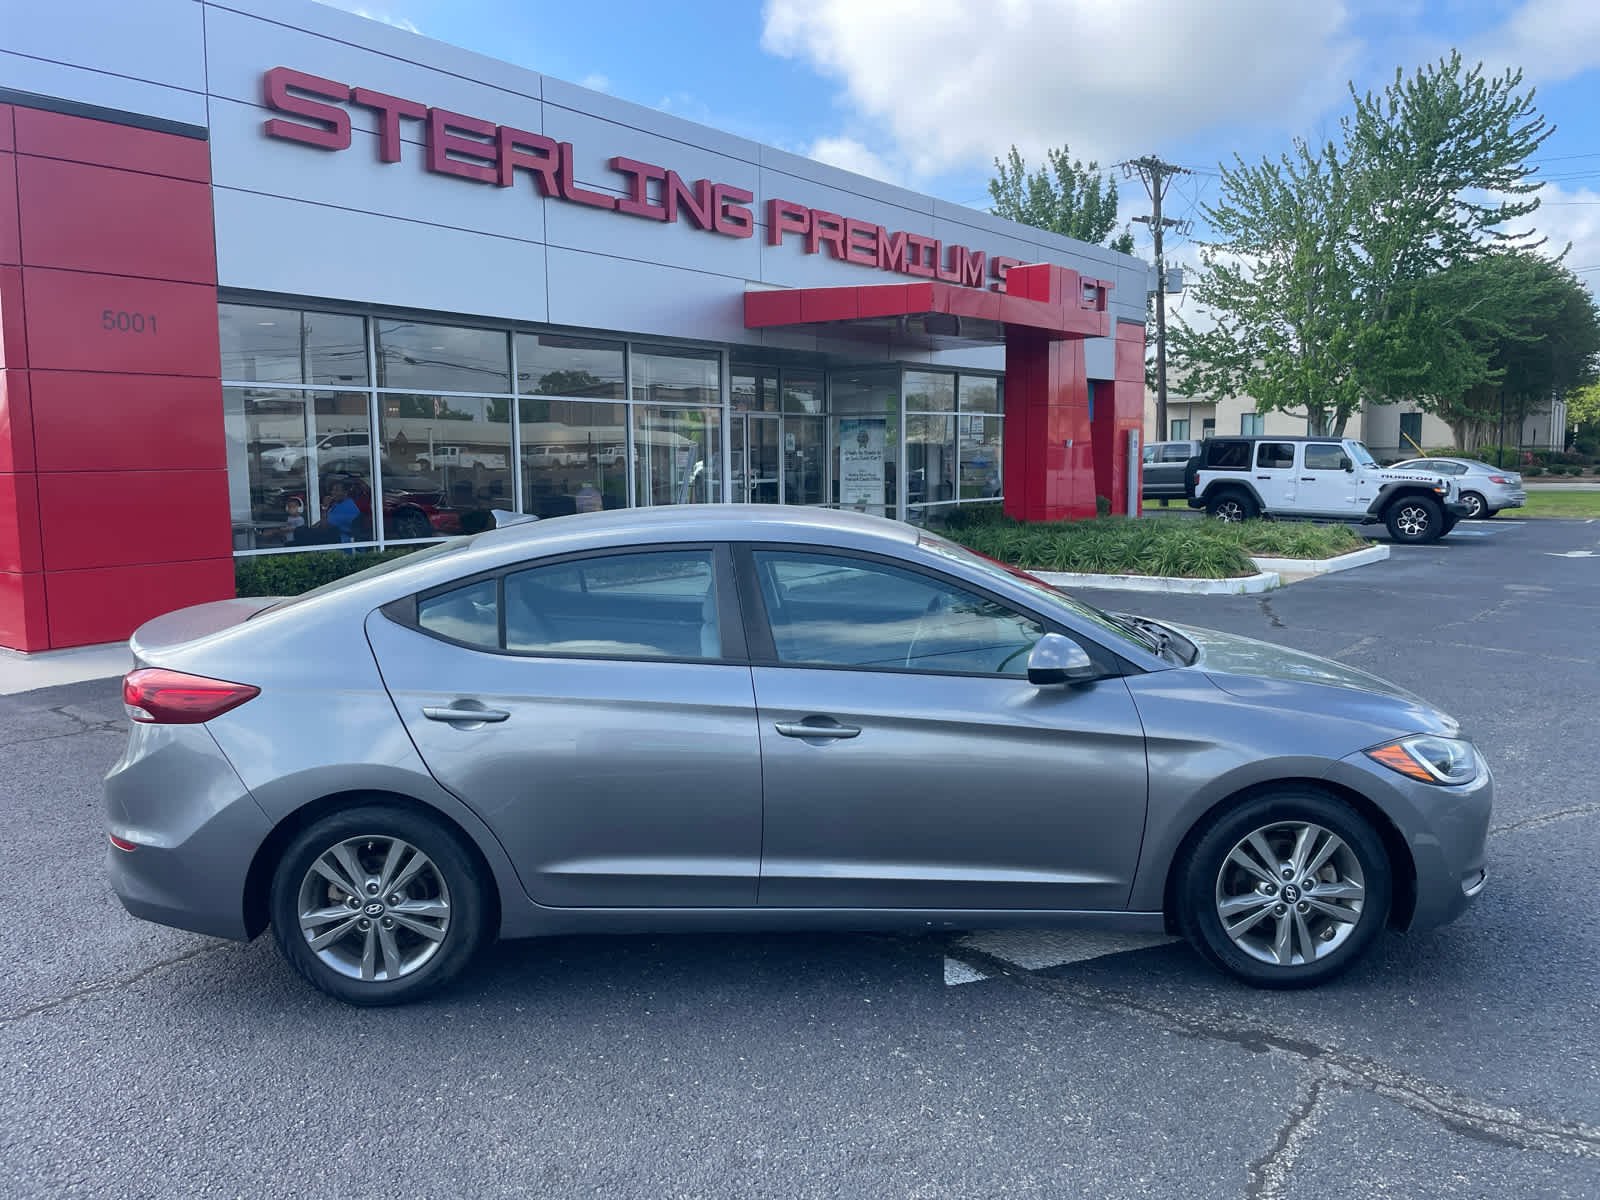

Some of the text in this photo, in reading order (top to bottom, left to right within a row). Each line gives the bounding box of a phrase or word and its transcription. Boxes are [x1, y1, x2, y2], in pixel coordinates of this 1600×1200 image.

[264, 66, 754, 236] STERLING
[767, 199, 985, 288] PREMIUM
[102, 309, 157, 335] 5001
